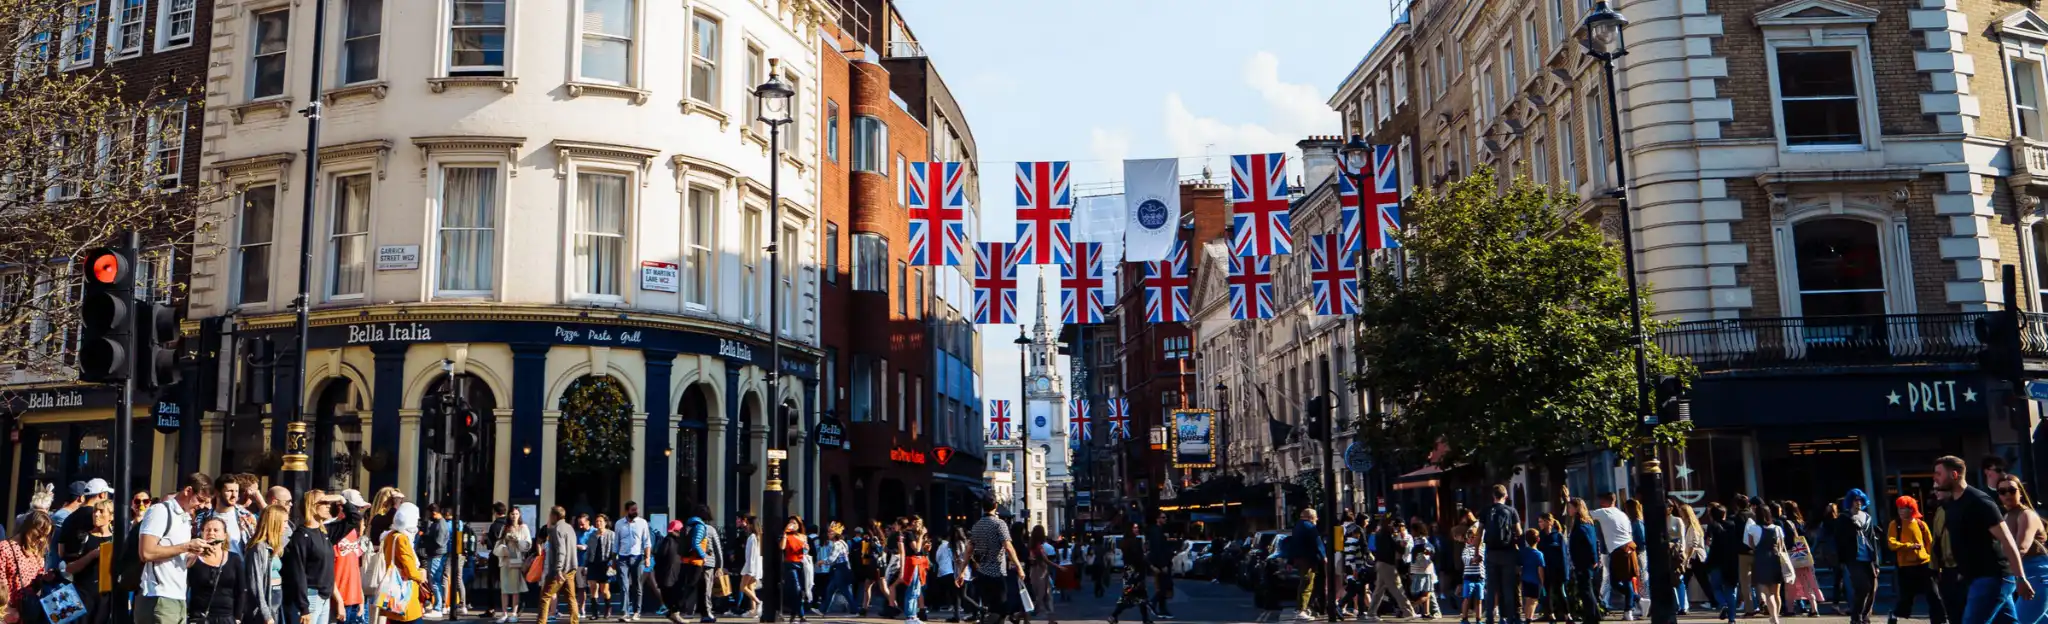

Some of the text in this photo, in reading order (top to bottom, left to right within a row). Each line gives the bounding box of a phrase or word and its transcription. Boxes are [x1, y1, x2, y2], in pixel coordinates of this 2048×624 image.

[380, 247, 405, 255] GARRICK
[380, 254, 401, 262] STREET
[645, 275, 658, 283] LANE
[347, 322, 432, 344] Bella Italia
[555, 325, 642, 344] Pizza Pasta Grill
[718, 338, 752, 361] Bella Italia
[28, 391, 83, 409] Bella Italia
[1907, 380, 1956, 412] PRET
[158, 401, 180, 414] Bella
[157, 414, 180, 427] Italia
[820, 423, 841, 435] Bella
[818, 434, 840, 446] Italia
